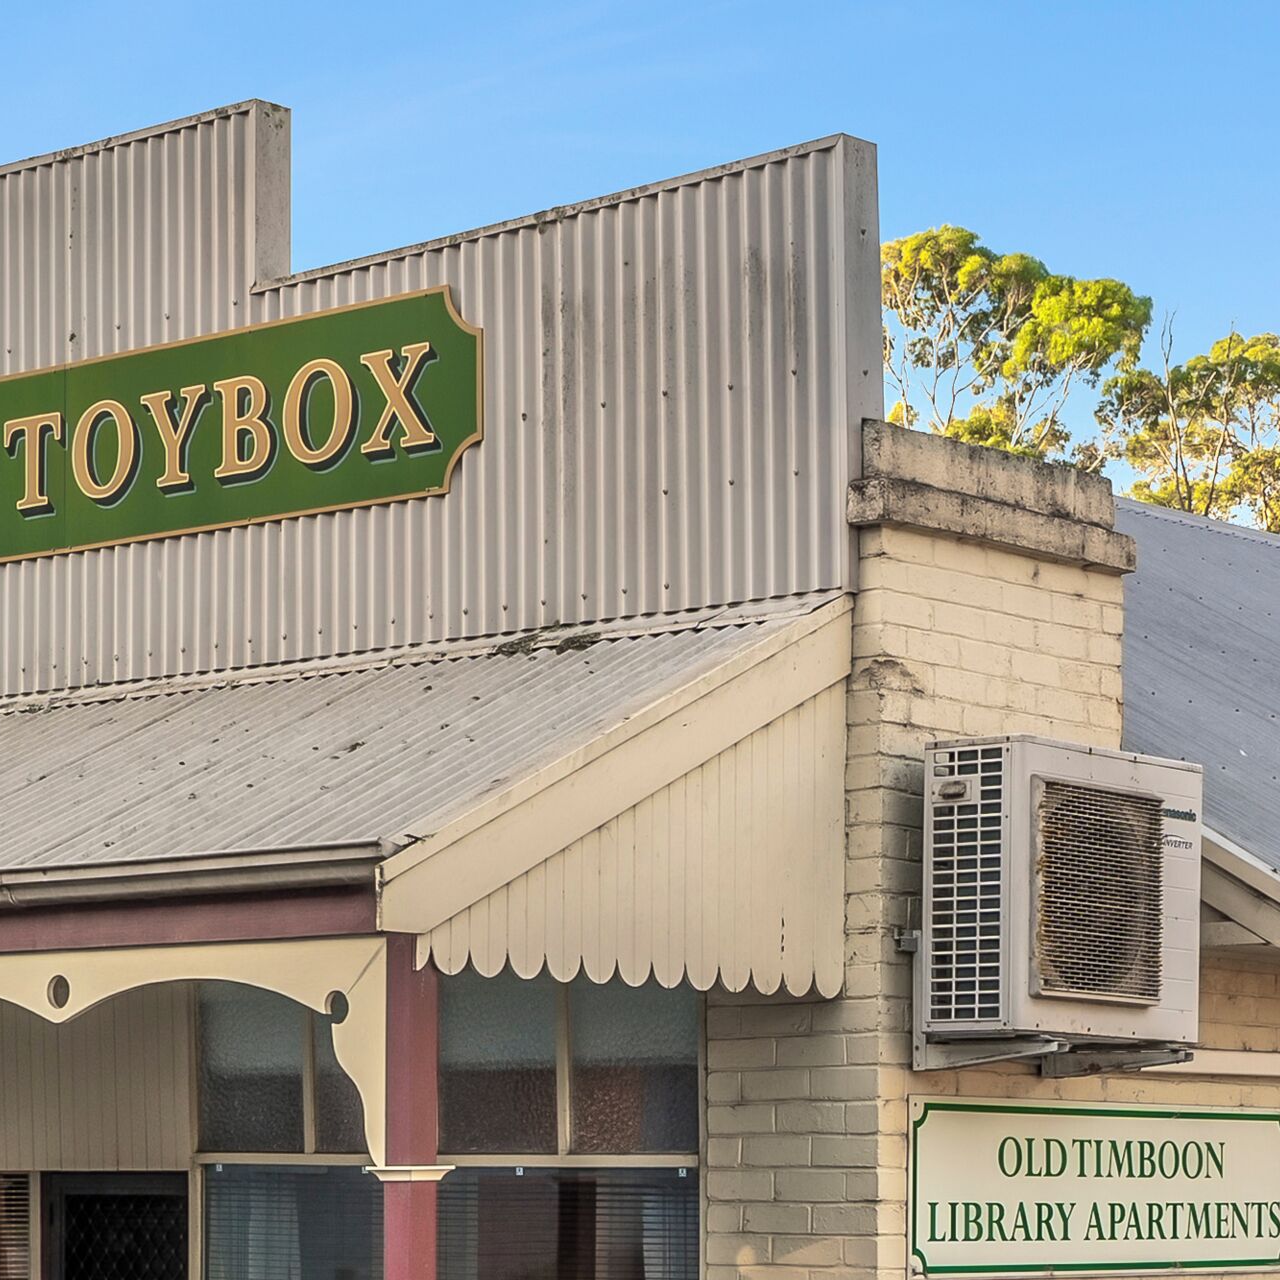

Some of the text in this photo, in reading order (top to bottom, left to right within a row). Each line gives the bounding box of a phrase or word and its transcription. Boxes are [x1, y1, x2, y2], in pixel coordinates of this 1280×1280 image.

[3, 341, 442, 520] TOYBOX
[1162, 808, 1197, 822] anasonic
[997, 1136, 1226, 1179] OLD TIMBOON
[927, 1200, 1280, 1242] LIBRARY APARTMENTS
